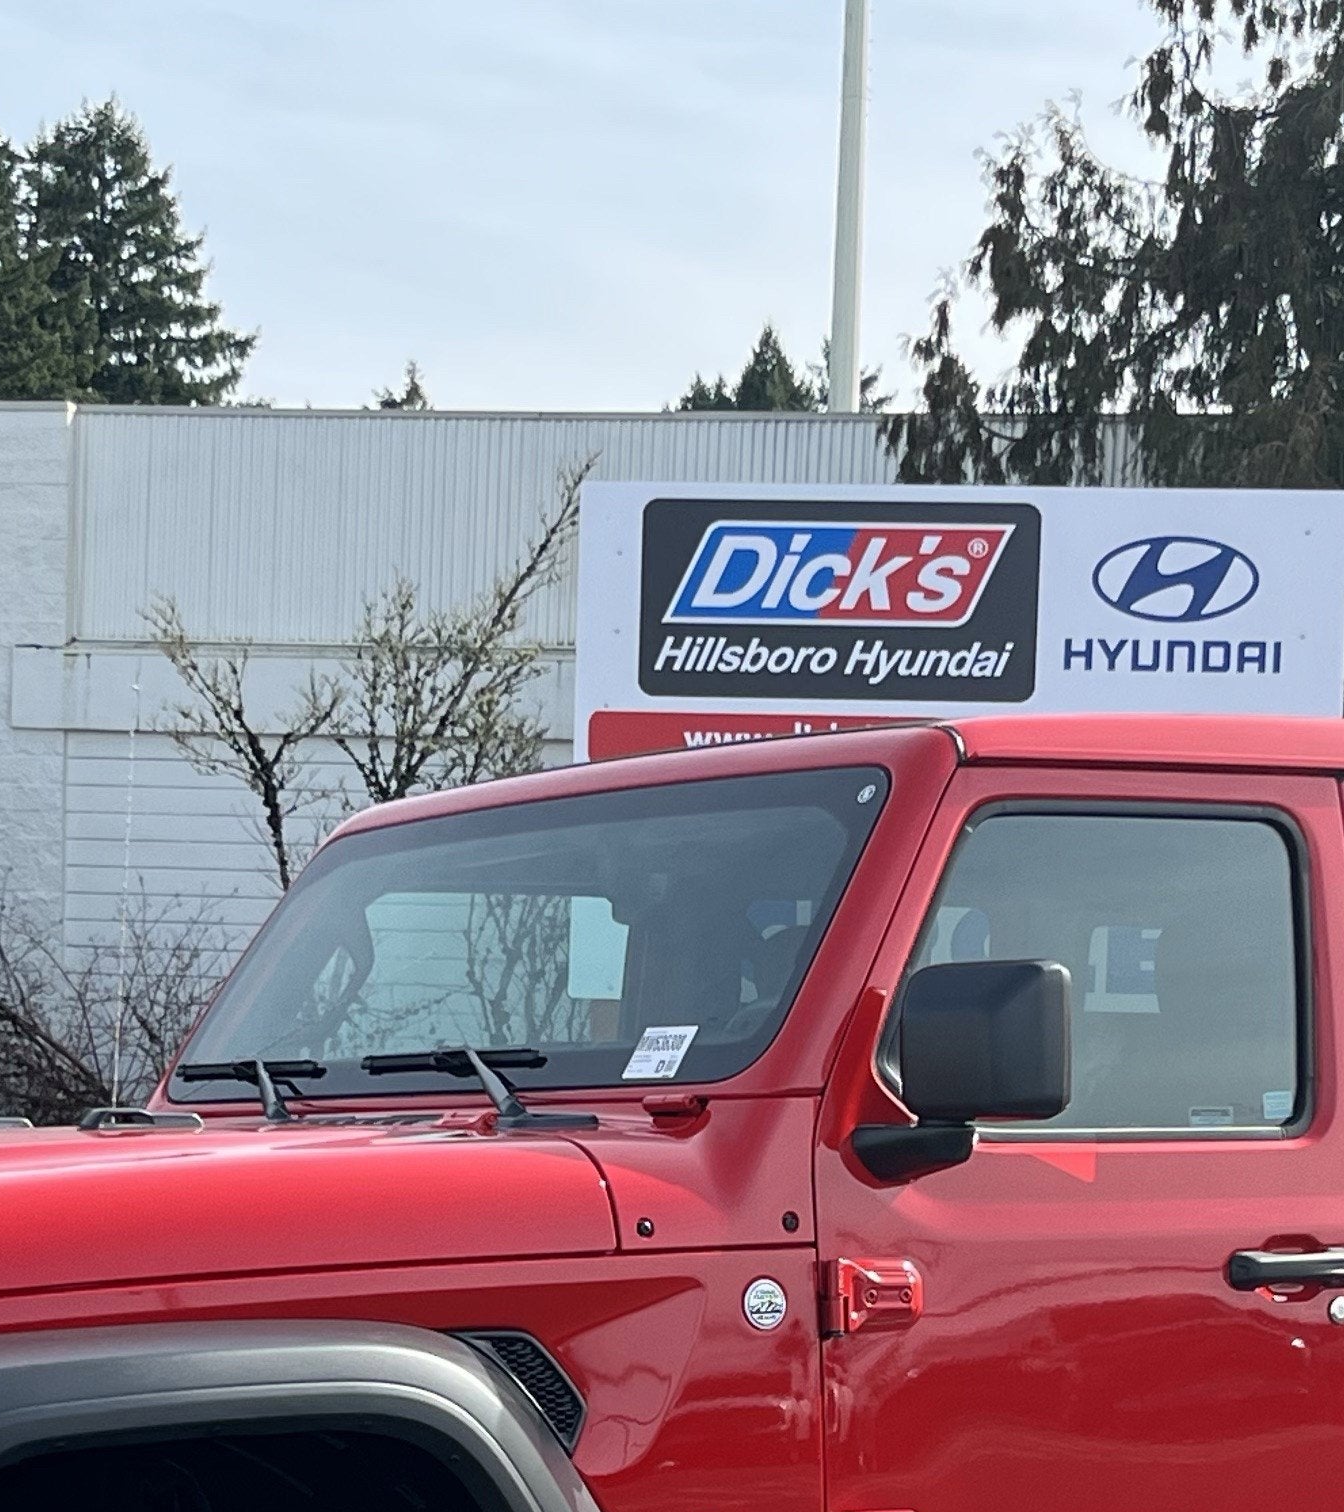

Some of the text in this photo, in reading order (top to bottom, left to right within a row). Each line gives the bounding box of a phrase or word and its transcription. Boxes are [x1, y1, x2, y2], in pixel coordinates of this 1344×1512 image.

[655, 635, 1016, 685] Hillsboro Hyundai
[1063, 638, 1282, 675] HYUNDAI
